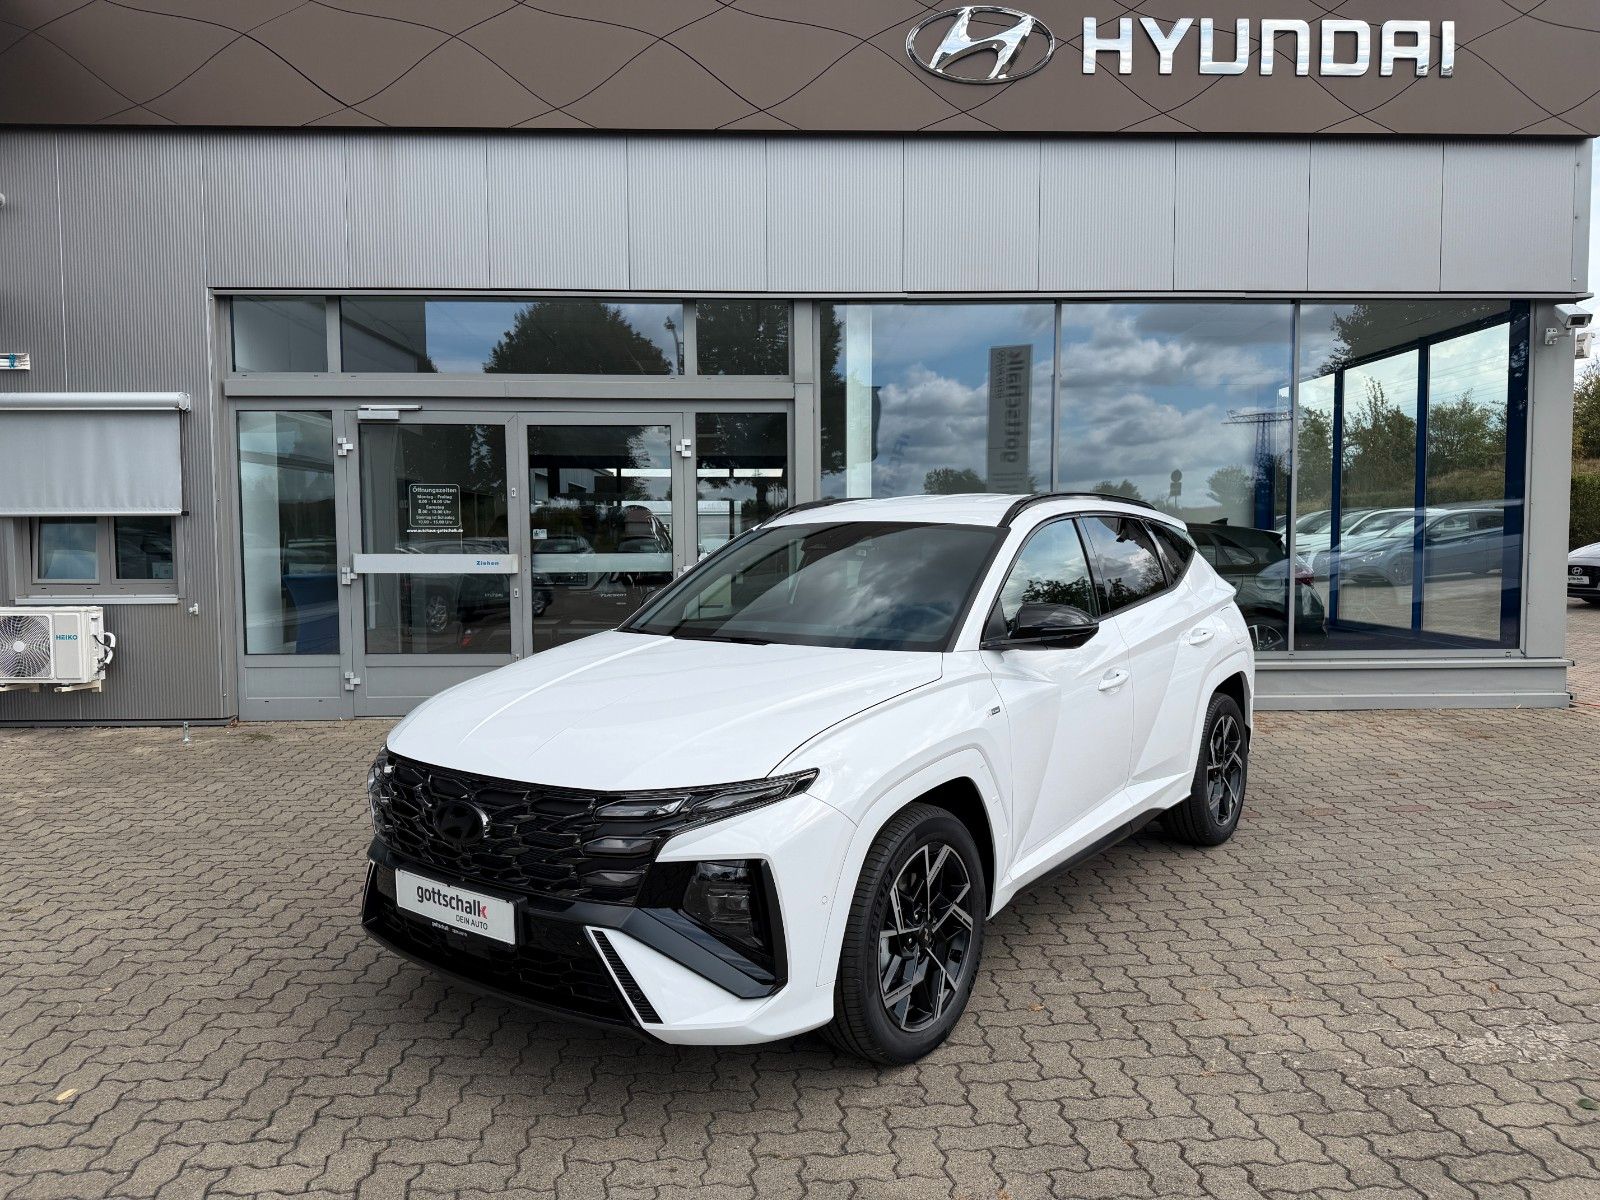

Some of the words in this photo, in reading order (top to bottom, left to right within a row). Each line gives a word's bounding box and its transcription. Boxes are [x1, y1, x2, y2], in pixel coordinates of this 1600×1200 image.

[1081, 16, 1455, 78] HYUNDAI
[416, 885, 488, 920] gottschalk
[455, 914, 470, 925] DEIN
[470, 919, 489, 931] AUTO
